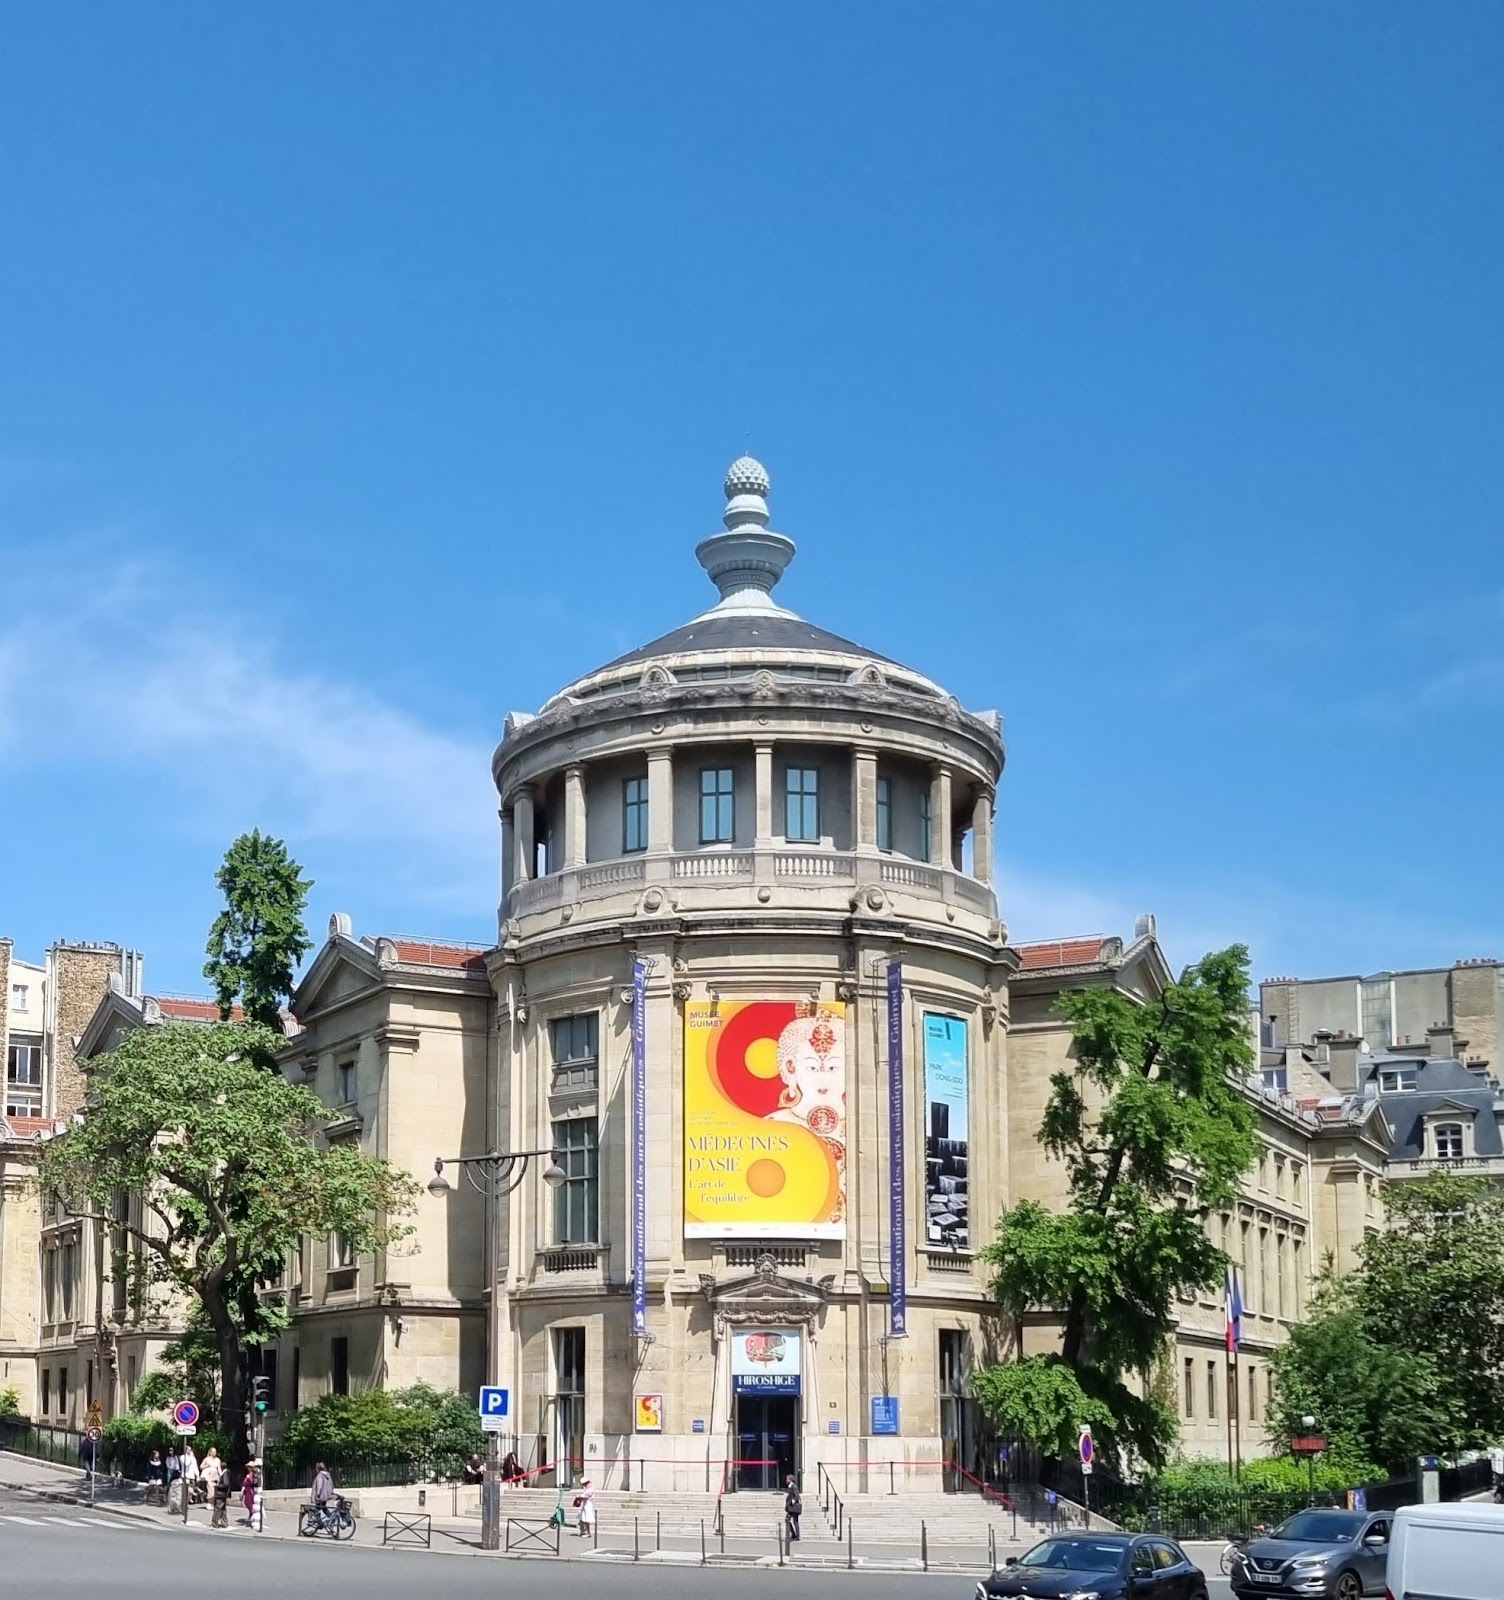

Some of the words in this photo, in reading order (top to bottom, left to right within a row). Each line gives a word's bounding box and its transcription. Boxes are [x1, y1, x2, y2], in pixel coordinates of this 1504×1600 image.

[635, 988, 644, 1042] Guimet
[890, 989, 900, 1043] Guimet
[636, 1059, 644, 1132] asiatiques
[892, 1059, 902, 1132] asiatiques
[689, 1133, 788, 1151] MÉDECINES
[689, 1157, 740, 1172] D'ASIE
[689, 1179, 712, 1189] L'art
[714, 1179, 727, 1189] de
[892, 1166, 901, 1191] des
[892, 1195, 902, 1254] national
[738, 1376, 796, 1386] HIROSHIGE
[488, 1393, 502, 1412] P
